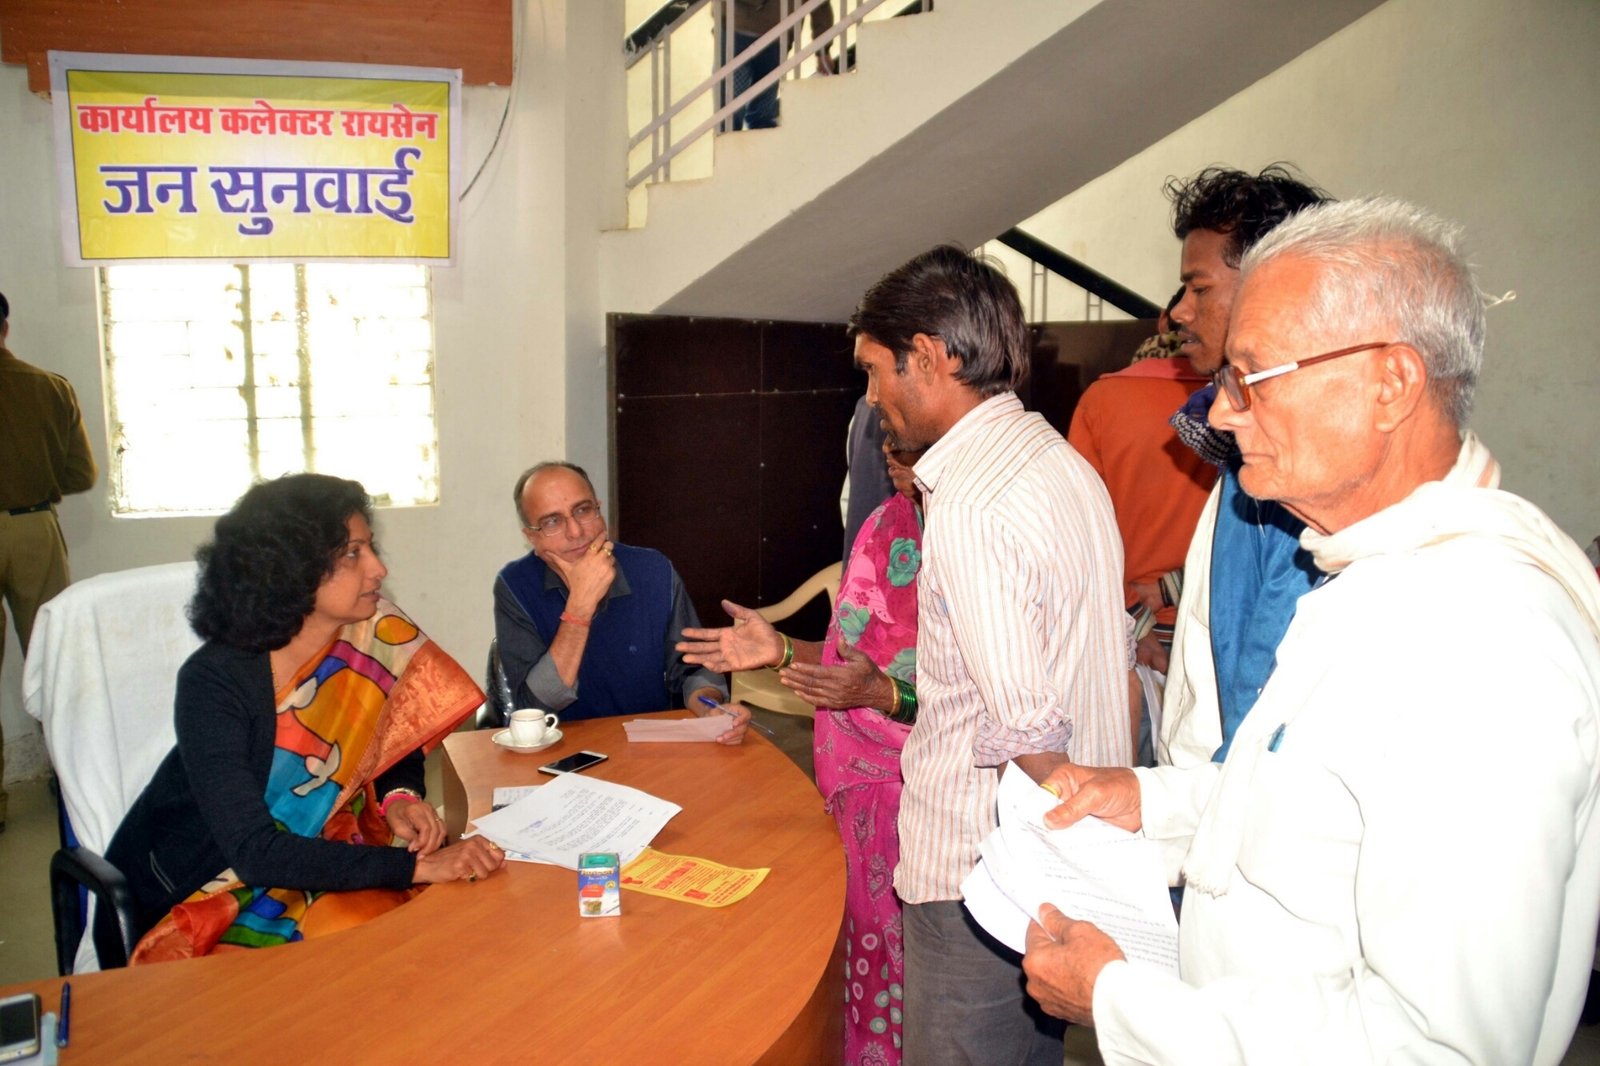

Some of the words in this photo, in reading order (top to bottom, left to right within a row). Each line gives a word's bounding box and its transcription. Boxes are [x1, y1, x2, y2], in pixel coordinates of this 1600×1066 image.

[77, 98, 212, 134] कार्यालय
[219, 100, 334, 136] कलेक्टर
[340, 104, 438, 139] रायसेन
[100, 166, 198, 213] जन
[209, 148, 421, 235] सुनवाई
